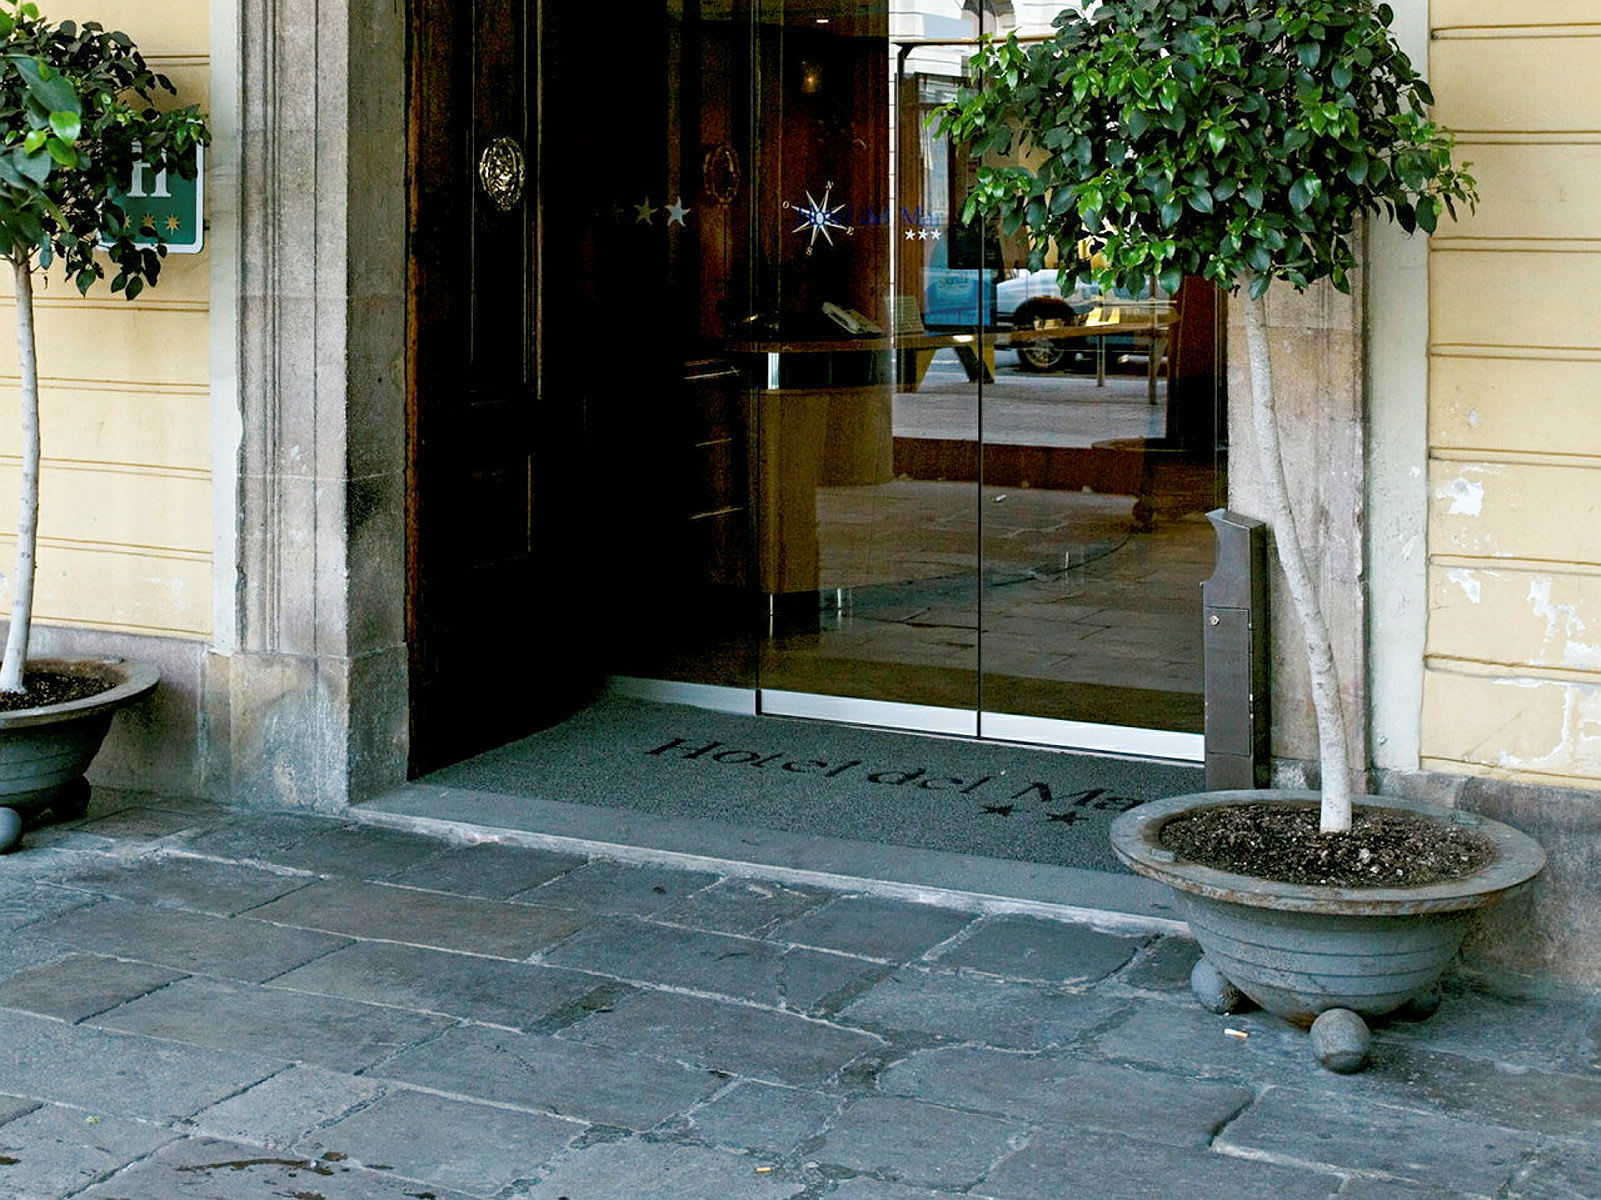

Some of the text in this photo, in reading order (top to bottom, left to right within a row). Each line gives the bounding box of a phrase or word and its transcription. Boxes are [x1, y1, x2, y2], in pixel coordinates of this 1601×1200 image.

[644, 738, 1148, 812] Hotel del Ma
